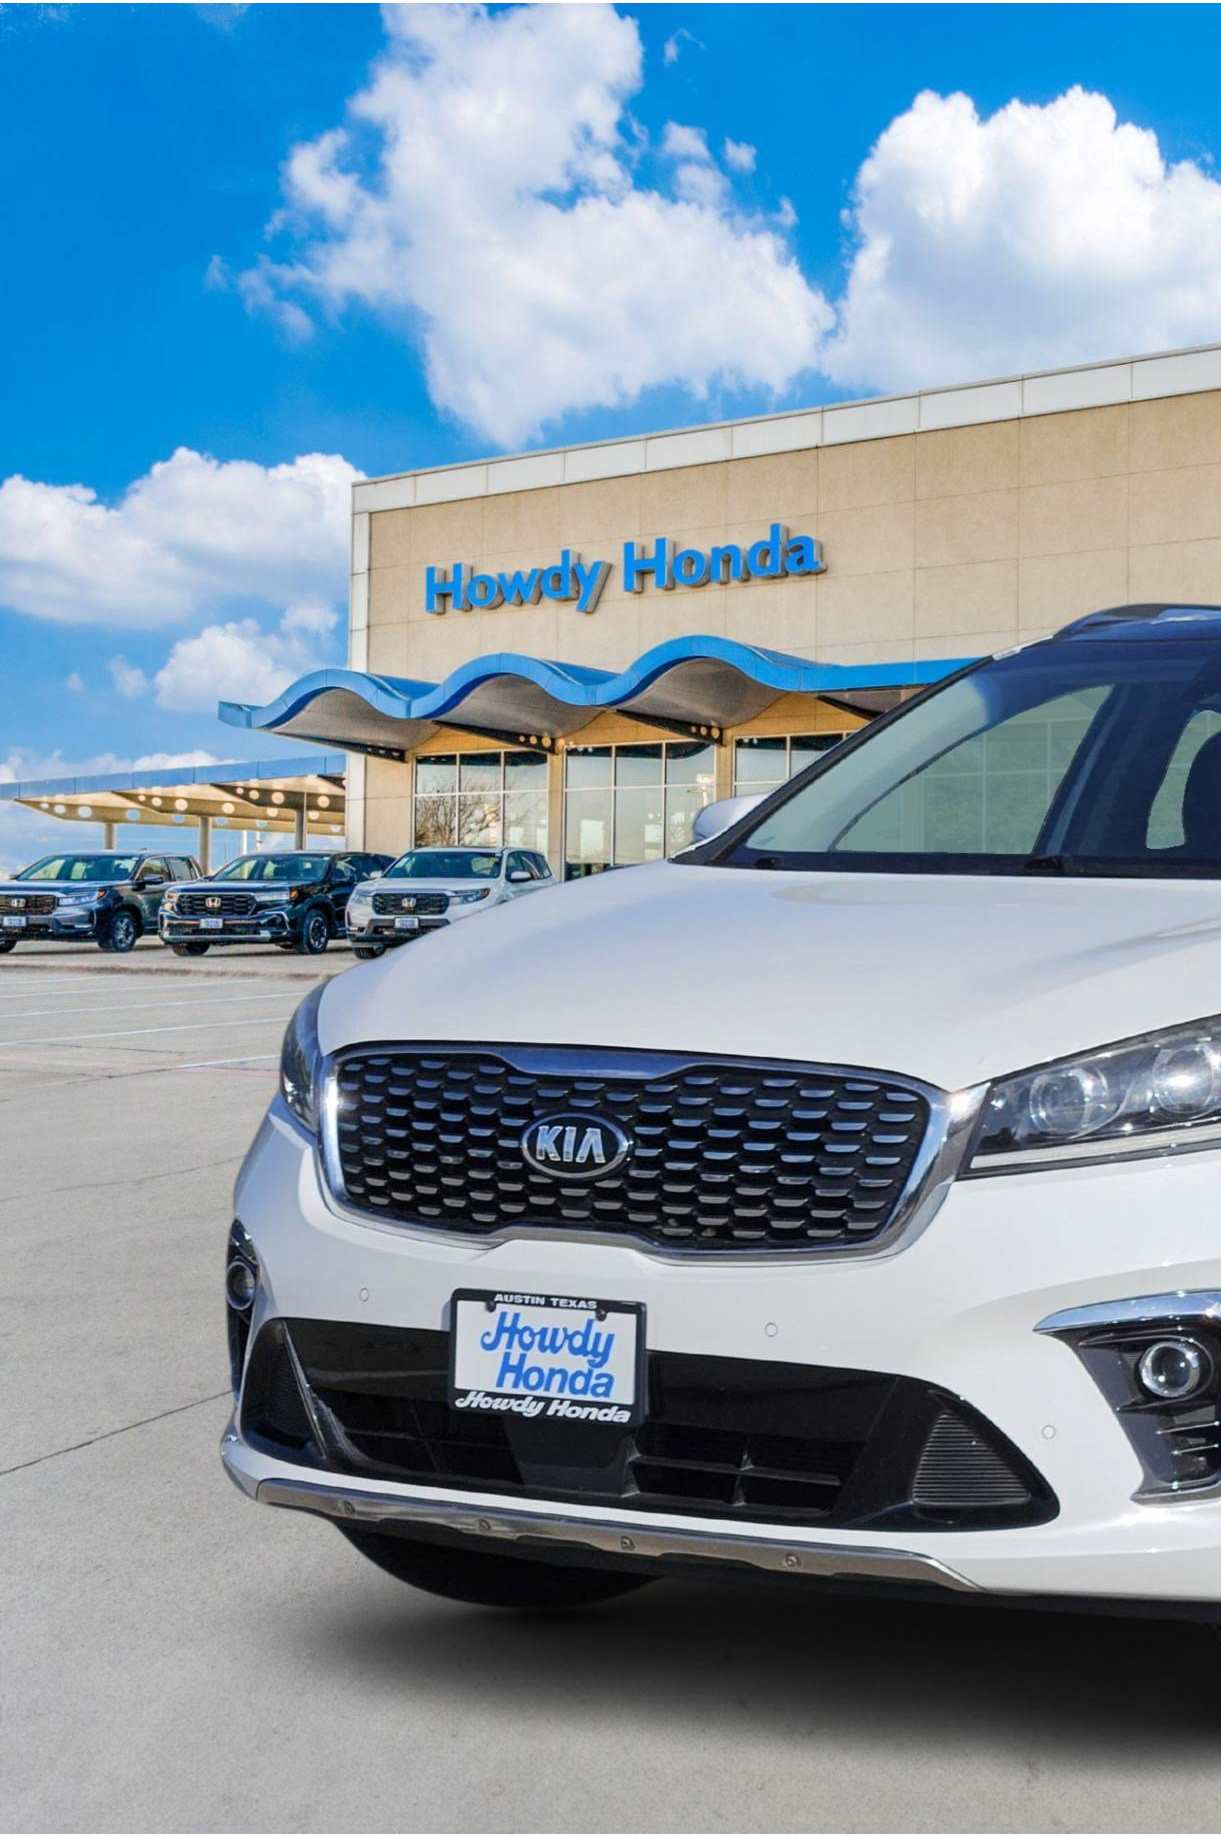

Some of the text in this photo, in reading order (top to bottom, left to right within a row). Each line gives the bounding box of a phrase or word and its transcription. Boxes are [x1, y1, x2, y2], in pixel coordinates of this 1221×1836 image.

[425, 523, 826, 614] Howdy Honda
[535, 1125, 606, 1163] KIA
[494, 1293, 598, 1310] AUSTIN TEXAS
[480, 1311, 616, 1368] Howdy
[496, 1352, 616, 1399] Honda
[454, 1391, 632, 1424] Howdy Honda
